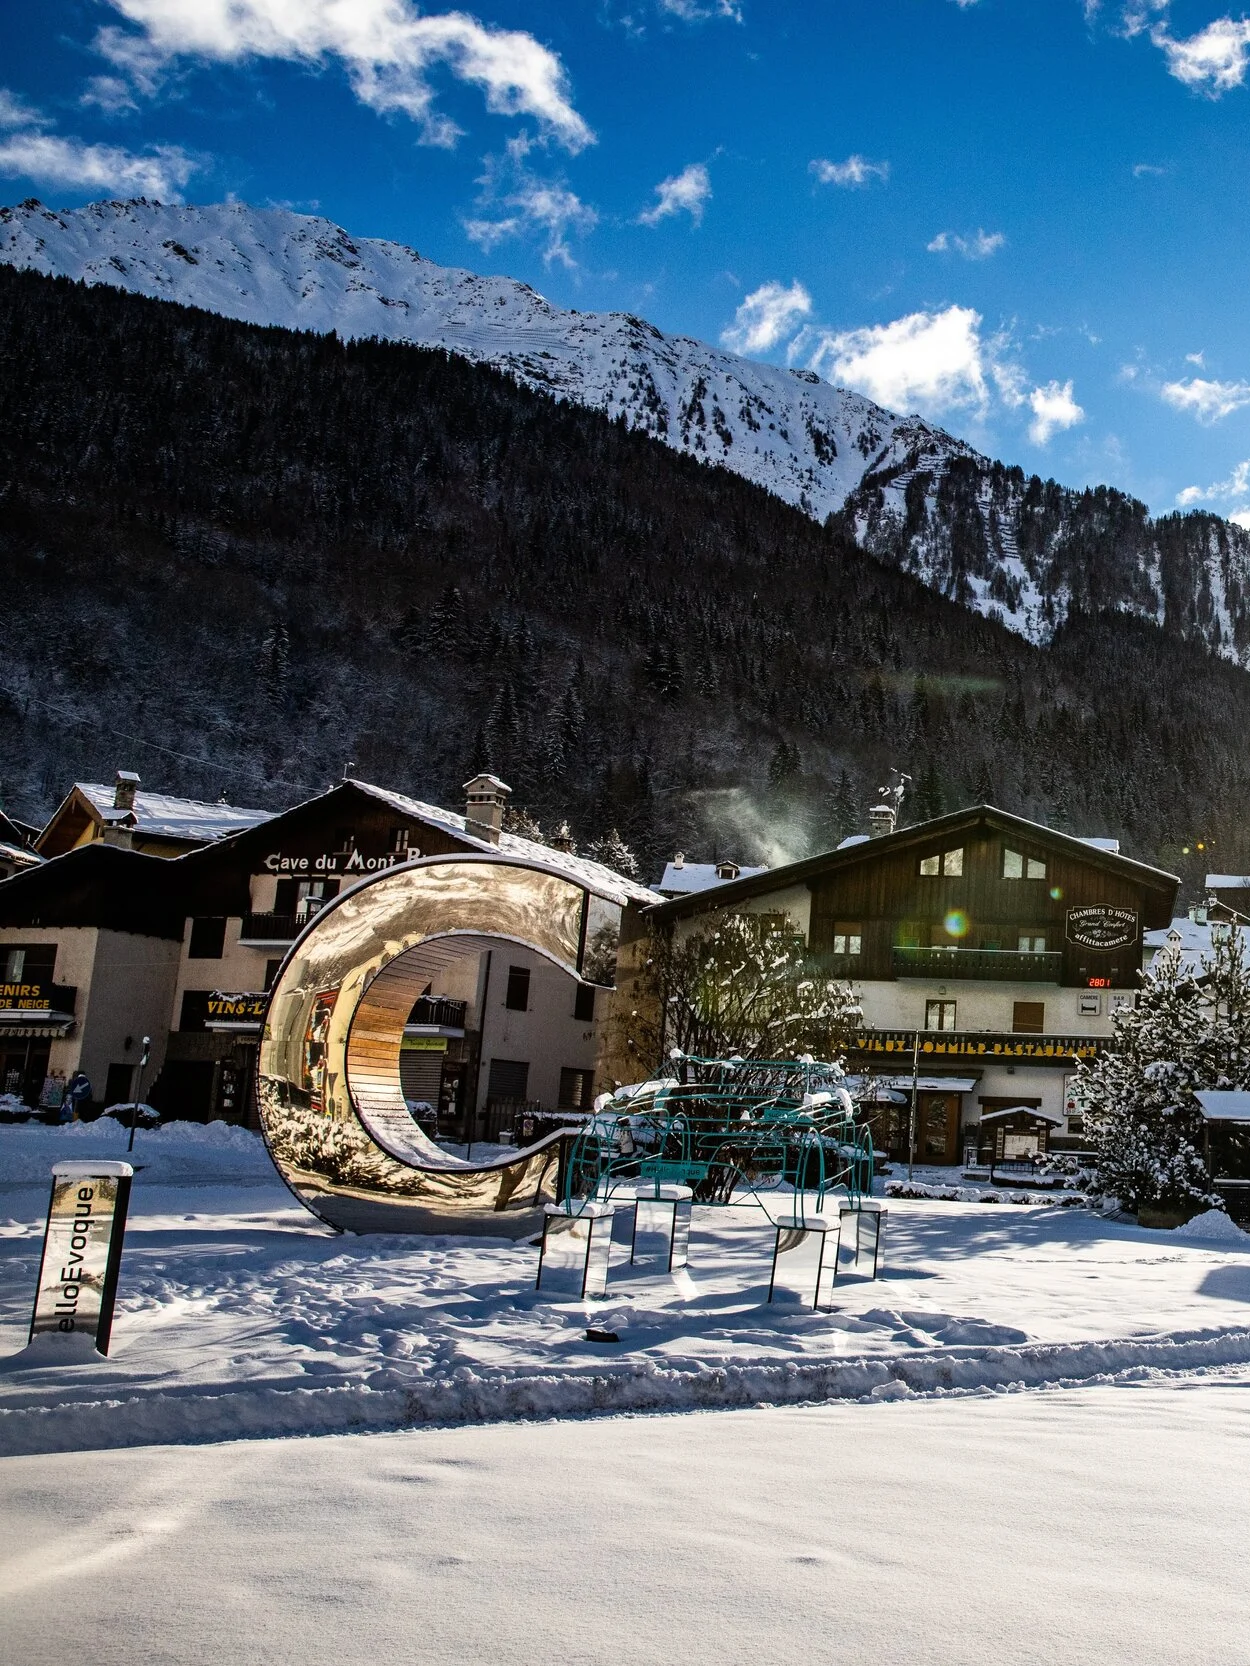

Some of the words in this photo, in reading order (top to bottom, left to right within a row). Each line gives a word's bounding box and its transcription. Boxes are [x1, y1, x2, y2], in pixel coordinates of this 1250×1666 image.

[264, 852, 309, 872] Cave
[315, 854, 337, 870] du
[344, 848, 396, 870] Mont
[1069, 908, 1106, 921] CHAMBRES
[1075, 933, 1128, 947] affittacamere
[17, 999, 50, 1009] NEIGE
[857, 1039, 905, 1052] VIEUX
[993, 1043, 1098, 1058] RESTAURANT
